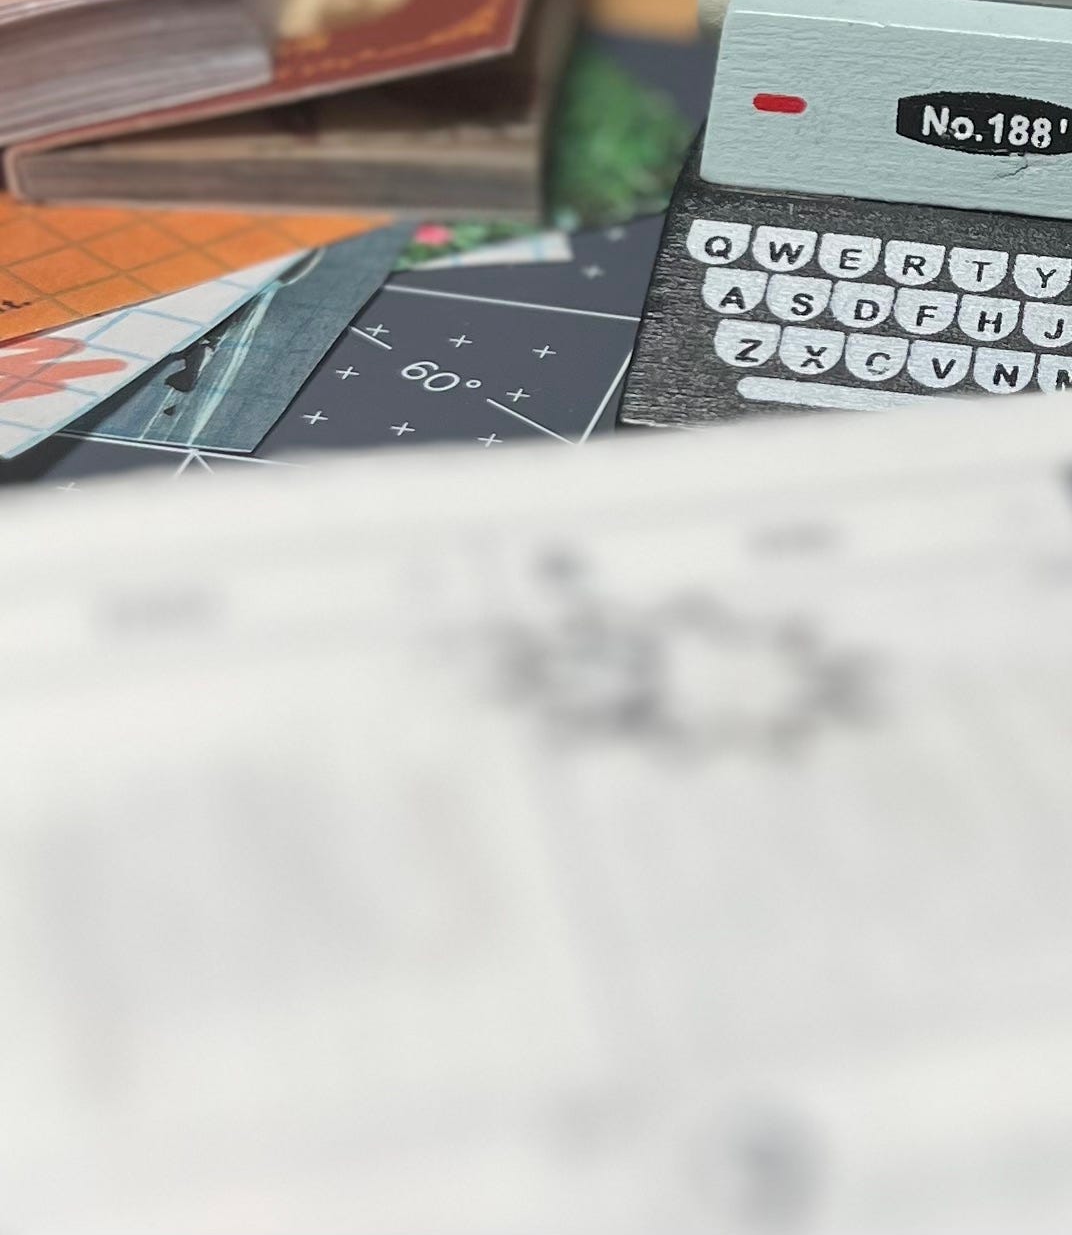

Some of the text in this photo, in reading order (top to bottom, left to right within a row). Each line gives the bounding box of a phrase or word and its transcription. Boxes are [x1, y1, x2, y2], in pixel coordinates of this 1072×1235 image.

[705, 236, 732, 260] Q
[769, 241, 804, 265] W
[839, 248, 863, 271] E
[902, 255, 926, 277] R
[972, 261, 992, 282] T
[1036, 267, 1057, 289] Y
[719, 286, 746, 310] A
[791, 293, 815, 316] S
[854, 299, 880, 321] D
[916, 305, 938, 326] F
[978, 311, 1002, 333] H
[1044, 319, 1065, 340] J
[735, 338, 763, 362] Z
[801, 345, 828, 369] X
[865, 352, 891, 375] C
[931, 357, 957, 380] V
[993, 362, 1019, 387] N
